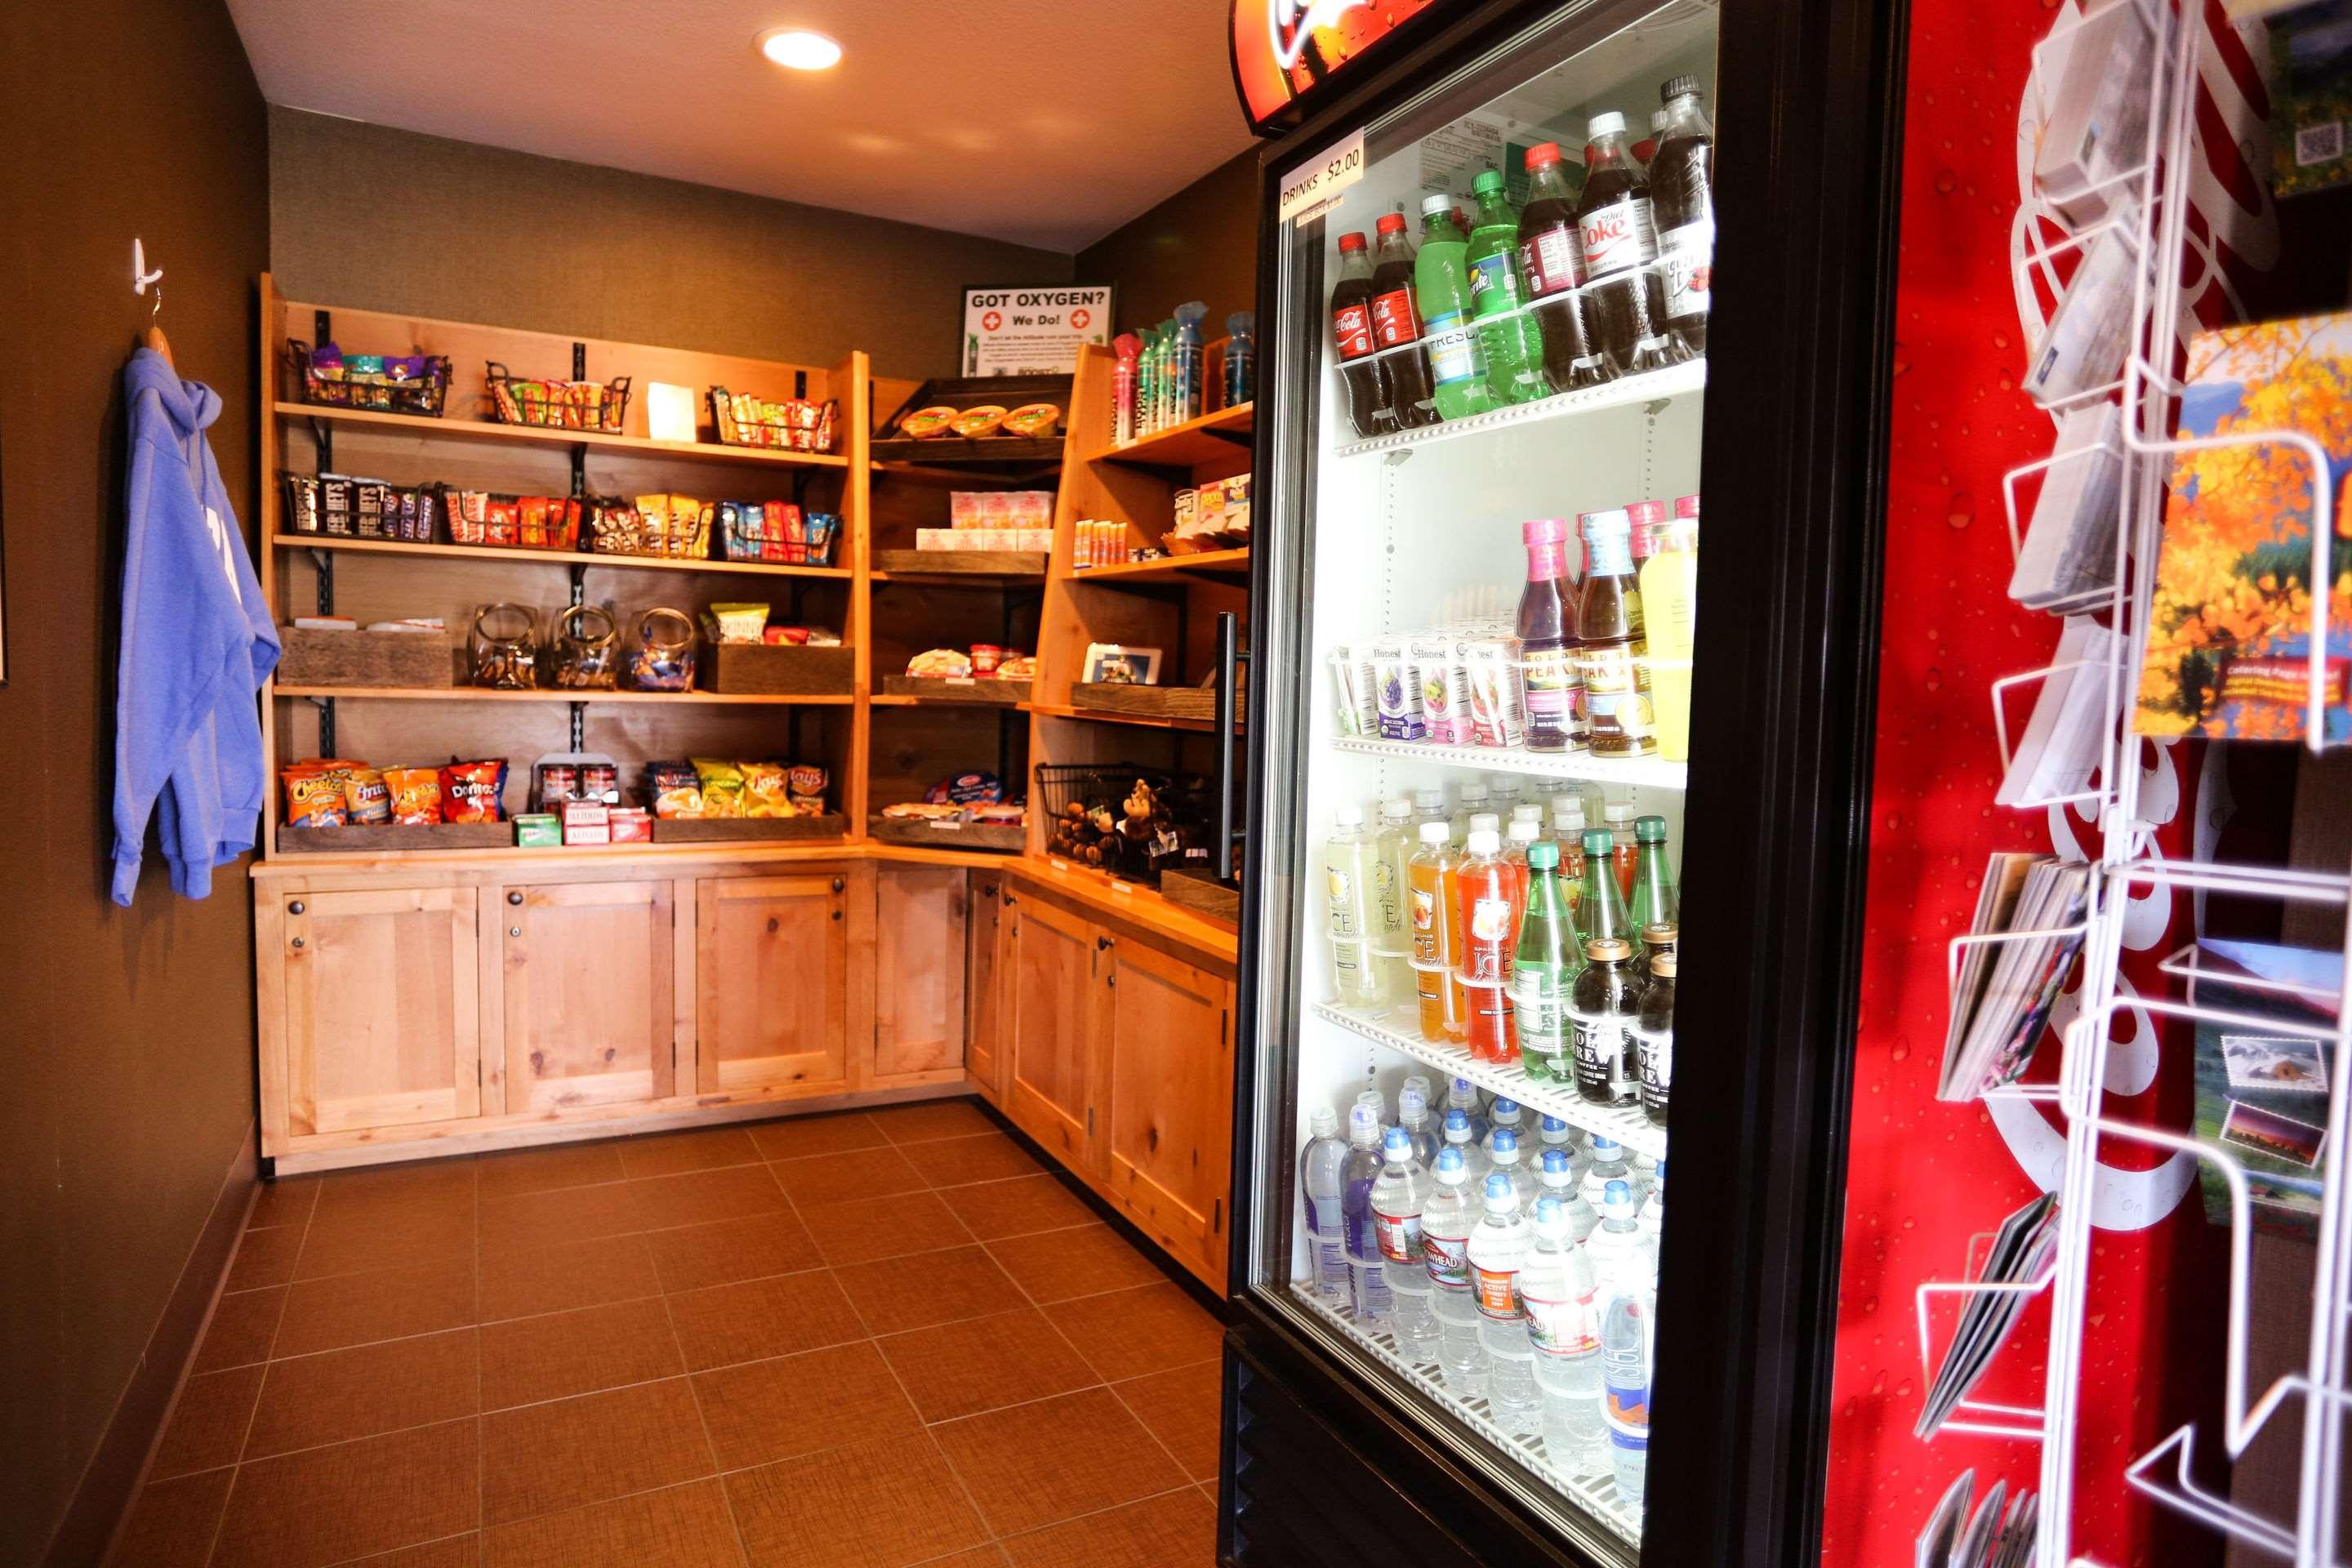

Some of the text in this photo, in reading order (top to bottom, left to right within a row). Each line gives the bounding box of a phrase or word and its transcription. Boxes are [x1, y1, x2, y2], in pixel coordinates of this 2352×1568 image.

[1282, 149, 1360, 207] DRINKS $2.00
[1581, 219, 1625, 249] Coke
[972, 291, 1105, 308] GOT OXYGEN?
[1013, 314, 1061, 326] We Do!
[720, 619, 760, 635] SKINNY
[1374, 648, 1401, 658] Honest
[1418, 649, 1446, 659] Honest
[1525, 653, 1569, 662] GOLD
[2227, 666, 2271, 677] Coloring
[357, 784, 388, 801] Frito
[1332, 912, 1352, 933] CE
[1473, 950, 1513, 975] ICE
[1484, 1283, 1508, 1291] ACTIVE
